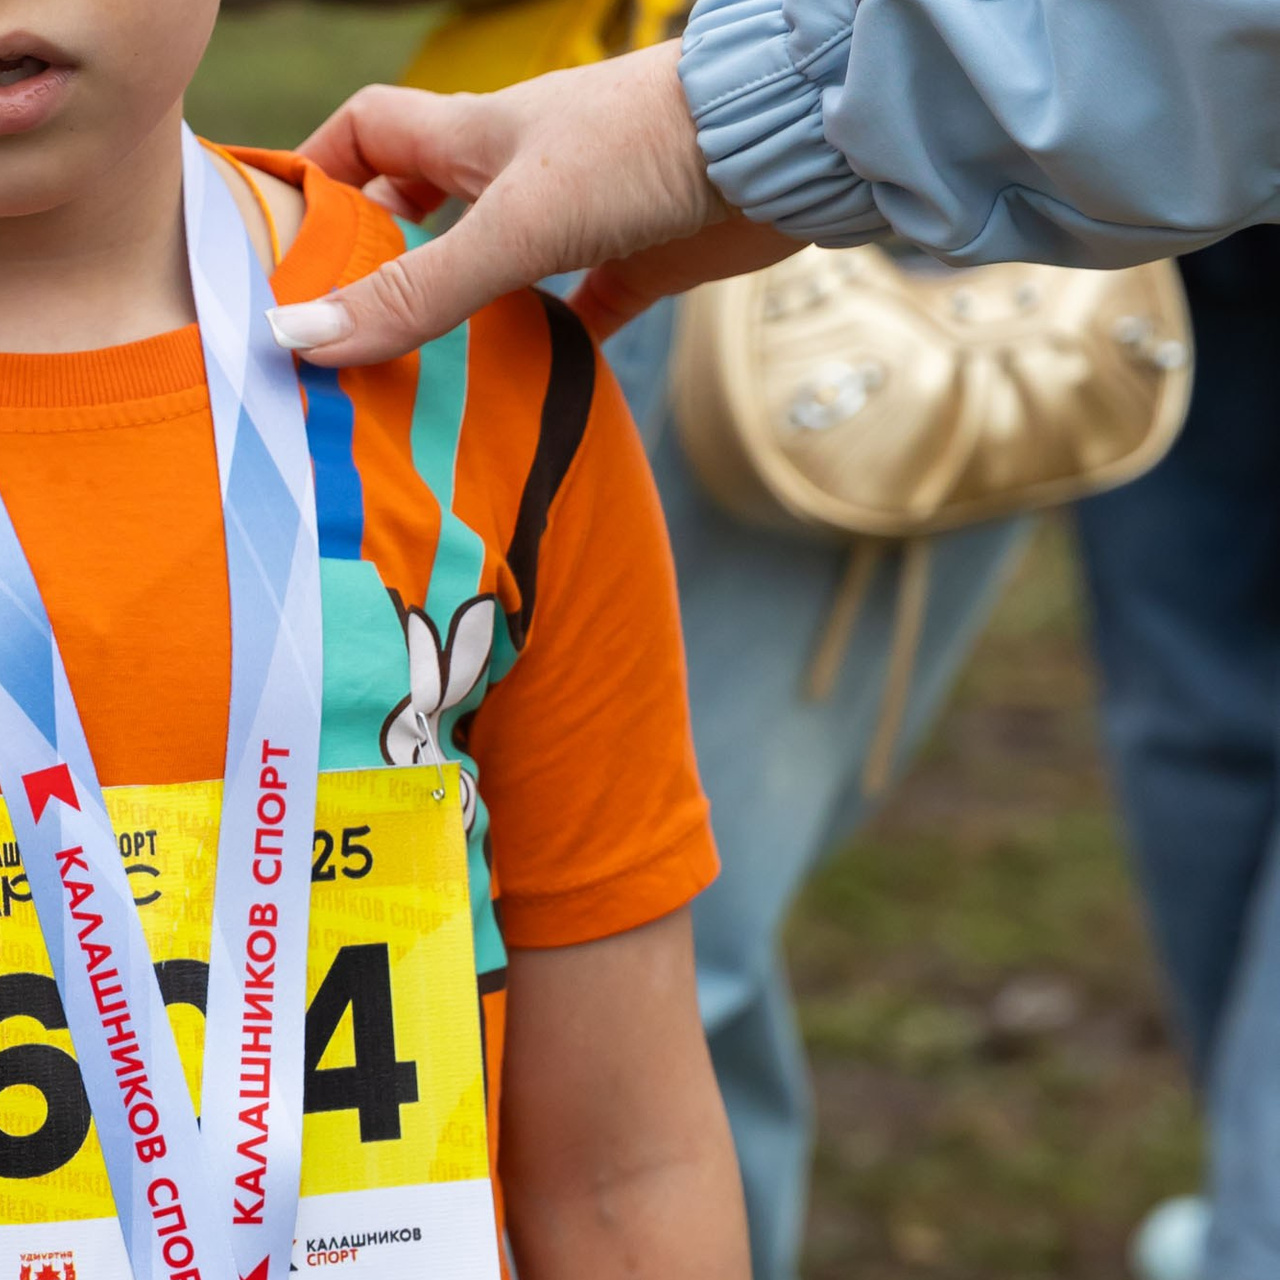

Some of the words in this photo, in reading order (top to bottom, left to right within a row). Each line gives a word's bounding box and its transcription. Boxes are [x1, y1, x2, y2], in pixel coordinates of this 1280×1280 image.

[252, 739, 291, 886] СПОРТ
[117, 829, 157, 858] ОРТ
[312, 824, 373, 882] 25
[54, 846, 169, 1164] КАЛАШНИКОВ
[233, 903, 278, 1226] КАЛАШНИКОВ
[306, 1227, 422, 1253] КАЛАШНИКОВ
[306, 1247, 359, 1267] СПОРТ
